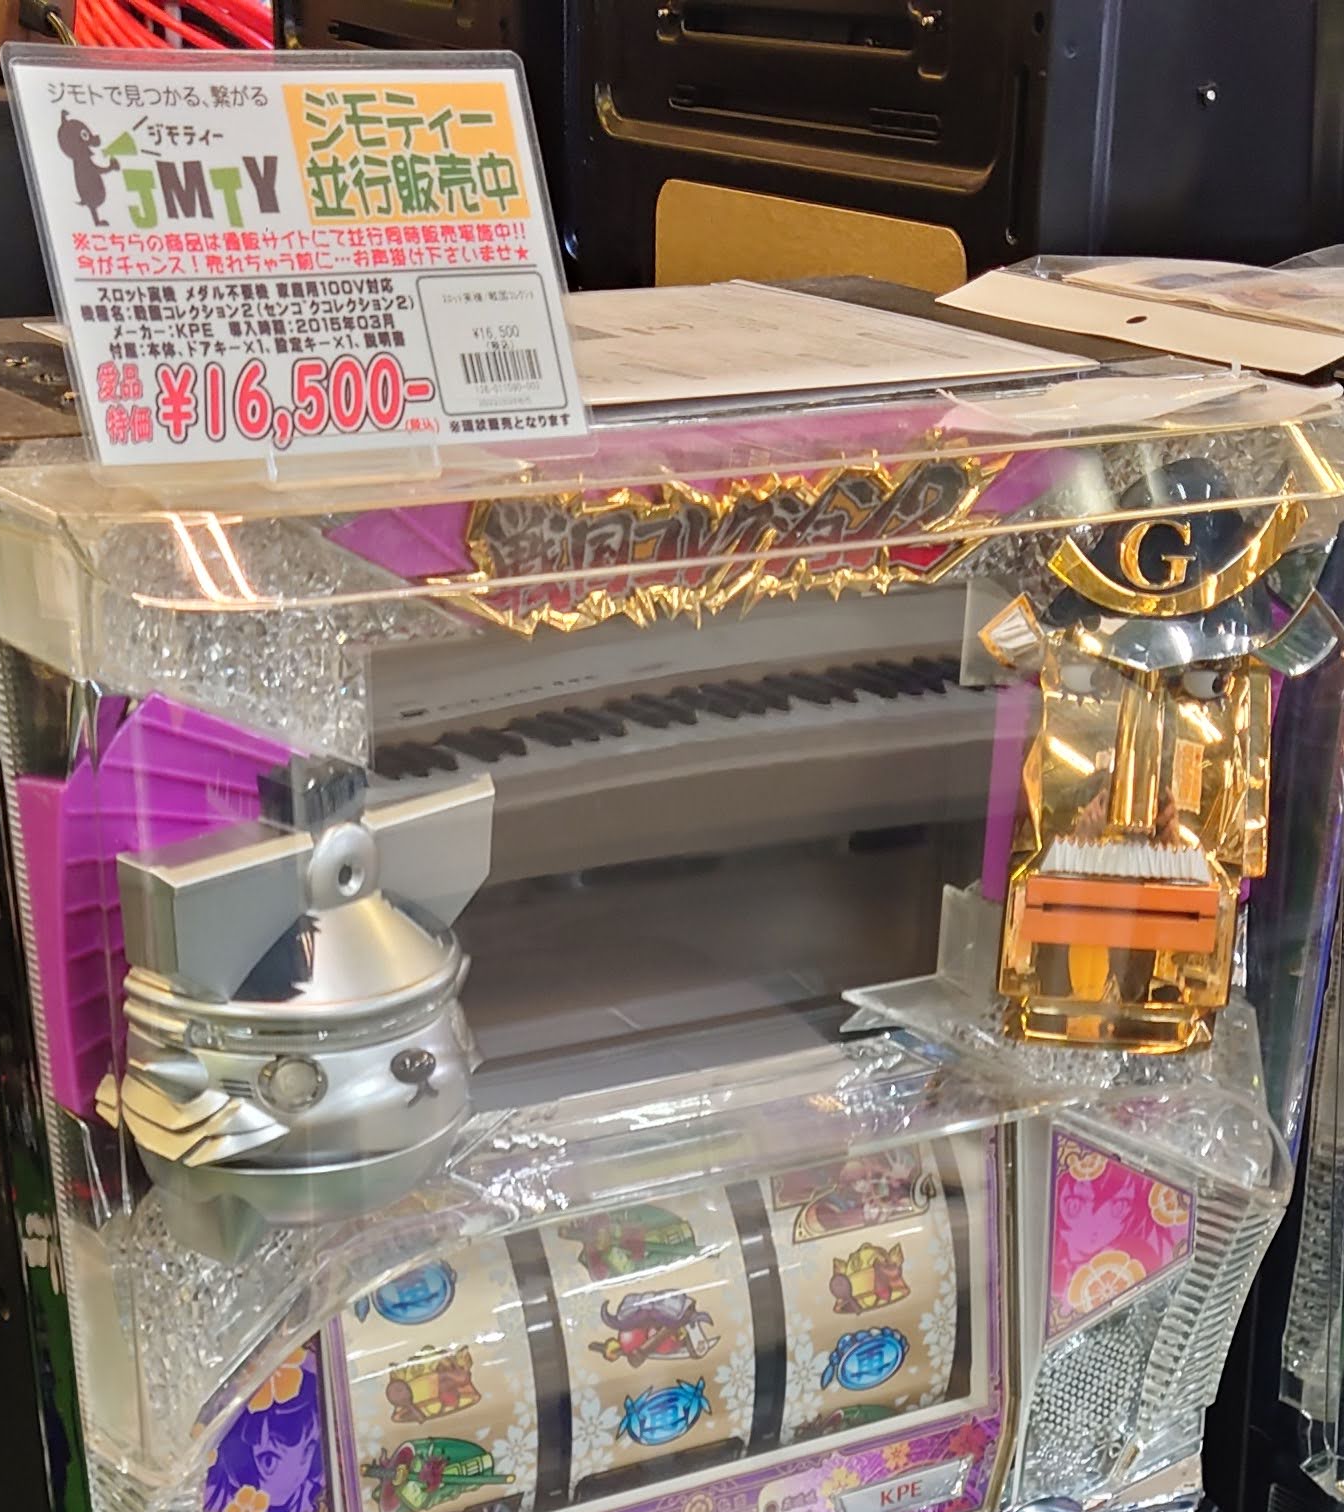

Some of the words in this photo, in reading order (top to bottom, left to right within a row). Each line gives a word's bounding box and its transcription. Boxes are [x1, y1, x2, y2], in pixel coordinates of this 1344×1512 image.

[47, 83, 268, 107] ジモトで見つかる、繋がる
[147, 124, 224, 145] ジモティー
[305, 91, 493, 151] ジモティー
[122, 156, 280, 228] JMTY
[306, 153, 519, 217] 並行販売中
[106, 404, 154, 444] 特価
[1120, 518, 1198, 591] G
[879, 1480, 924, 1507] KPE
